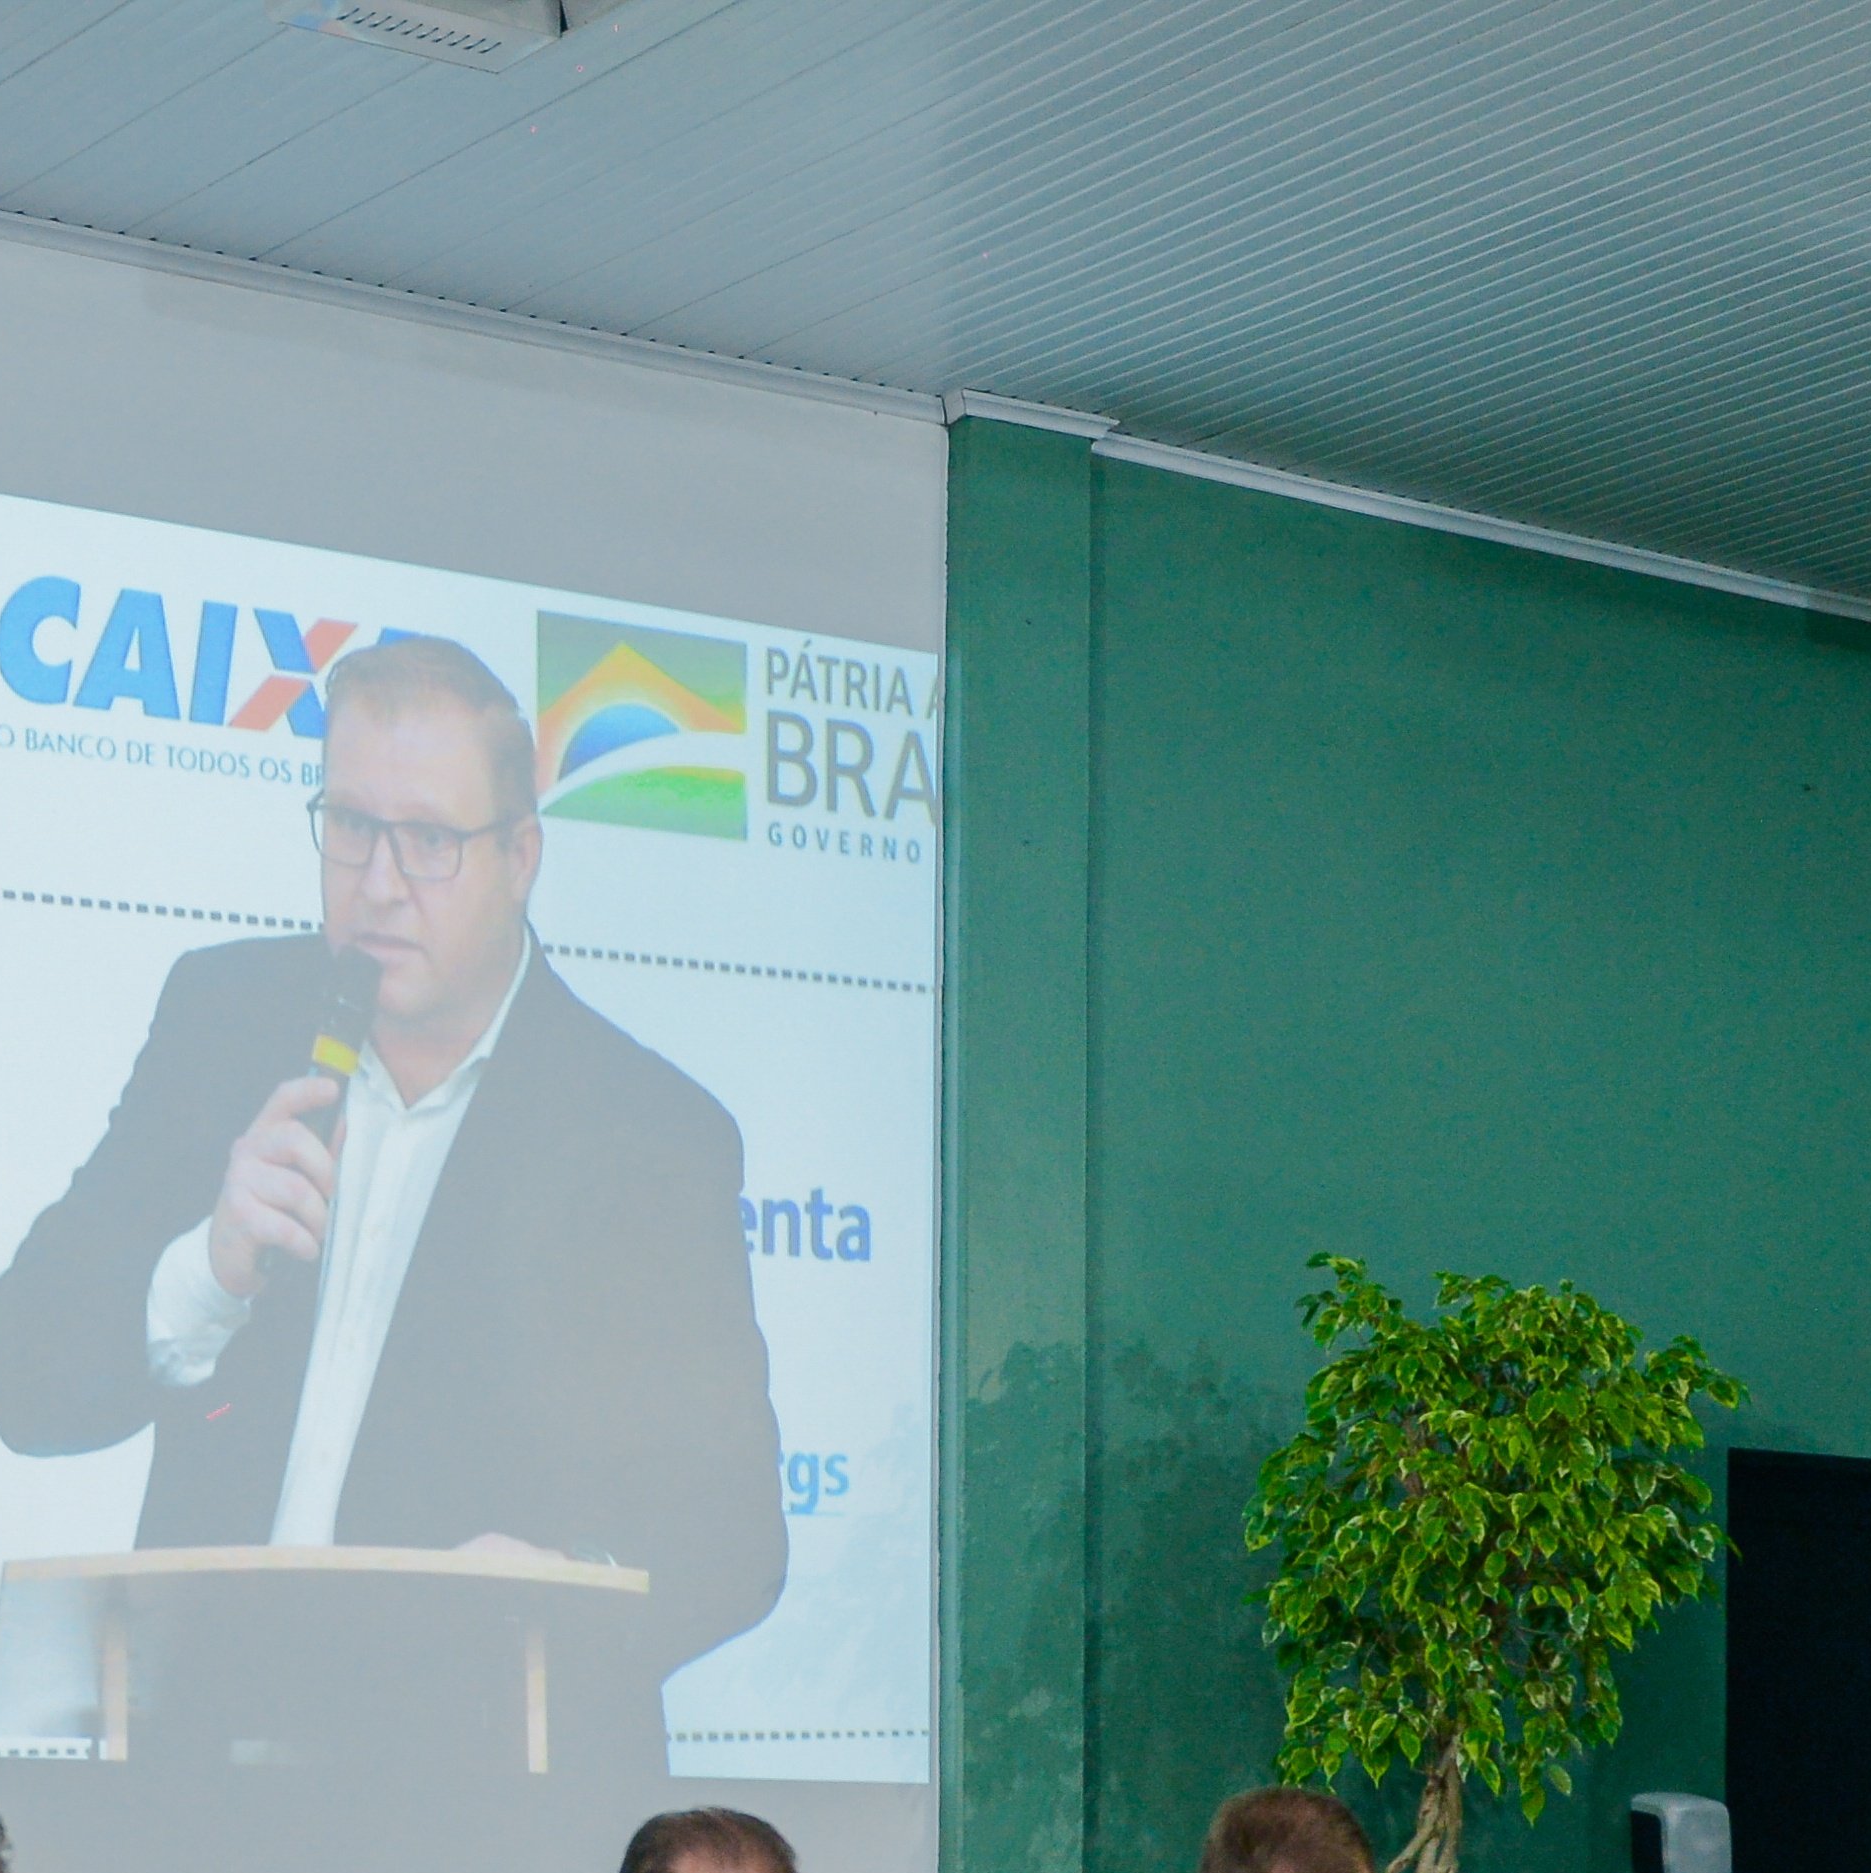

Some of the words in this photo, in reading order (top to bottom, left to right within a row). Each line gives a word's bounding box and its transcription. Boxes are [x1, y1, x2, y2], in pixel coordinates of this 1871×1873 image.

[766, 639, 913, 716] PÁTRIA
[25, 728, 117, 761] BANCO
[125, 740, 156, 766] DE
[166, 745, 250, 779] TODOS
[259, 758, 292, 784] OS
[767, 709, 936, 826] BRA
[768, 822, 921, 863] GOVERNO
[778, 1451, 849, 1515] gs
